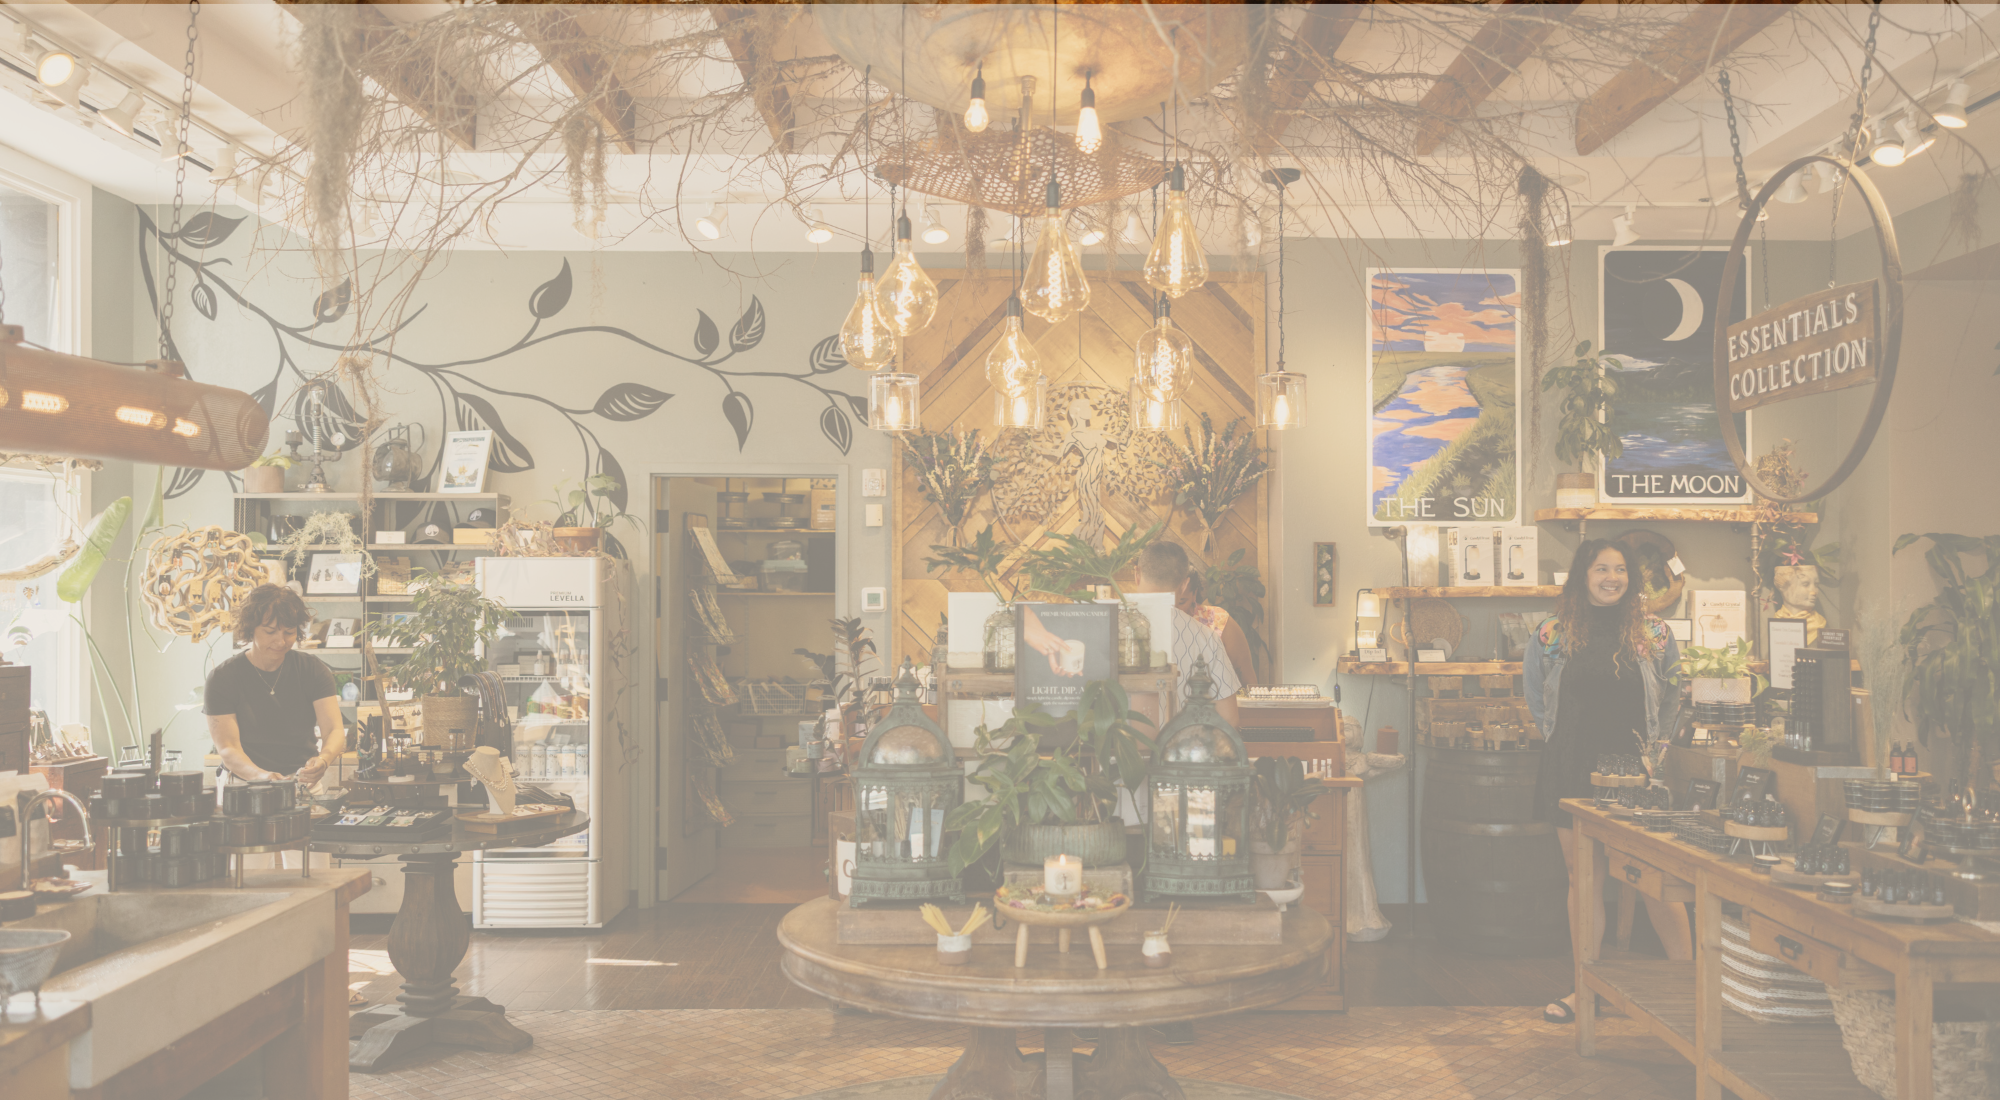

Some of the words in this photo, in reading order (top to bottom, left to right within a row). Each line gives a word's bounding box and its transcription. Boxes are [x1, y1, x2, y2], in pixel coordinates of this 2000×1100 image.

[1728, 292, 1858, 363] ESSENTIALS
[1730, 336, 1867, 401] COLLECTION
[1611, 474, 1665, 494] THE
[1668, 474, 1740, 494] MOON
[1379, 497, 1436, 517] THE
[1453, 496, 1505, 518] SUN
[1031, 686, 1060, 695] LIGHT.
[1061, 686, 1078, 695] DIP.
